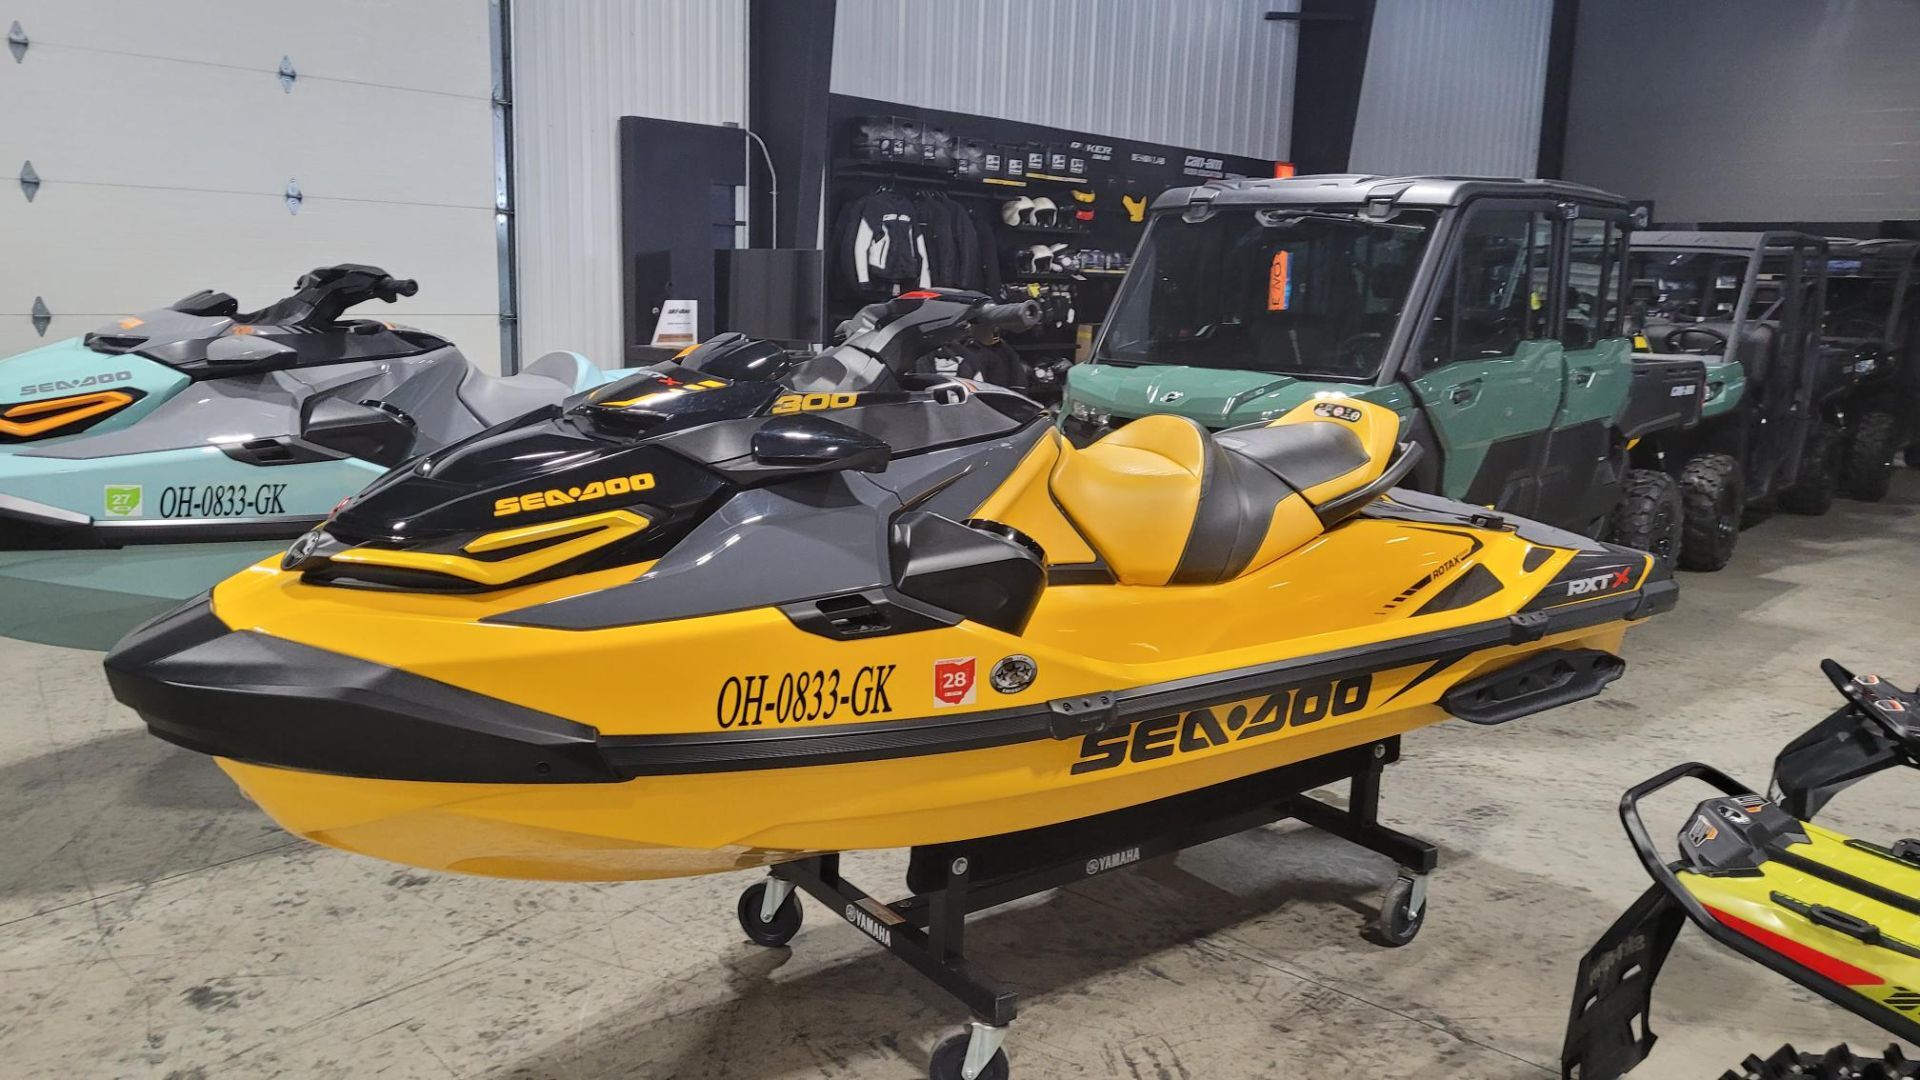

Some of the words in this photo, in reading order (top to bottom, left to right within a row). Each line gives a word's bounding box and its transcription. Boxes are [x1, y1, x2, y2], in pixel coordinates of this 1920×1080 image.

[771, 392, 859, 415] 300
[111, 494, 132, 505] 27
[160, 483, 287, 519] OH-0833-GK
[1432, 556, 1461, 580] ROTAX
[942, 671, 967, 689] 28
[716, 664, 897, 729] OH-0833-GK
[1097, 847, 1141, 871] YAMAHA
[855, 910, 892, 947] YAMAHA
